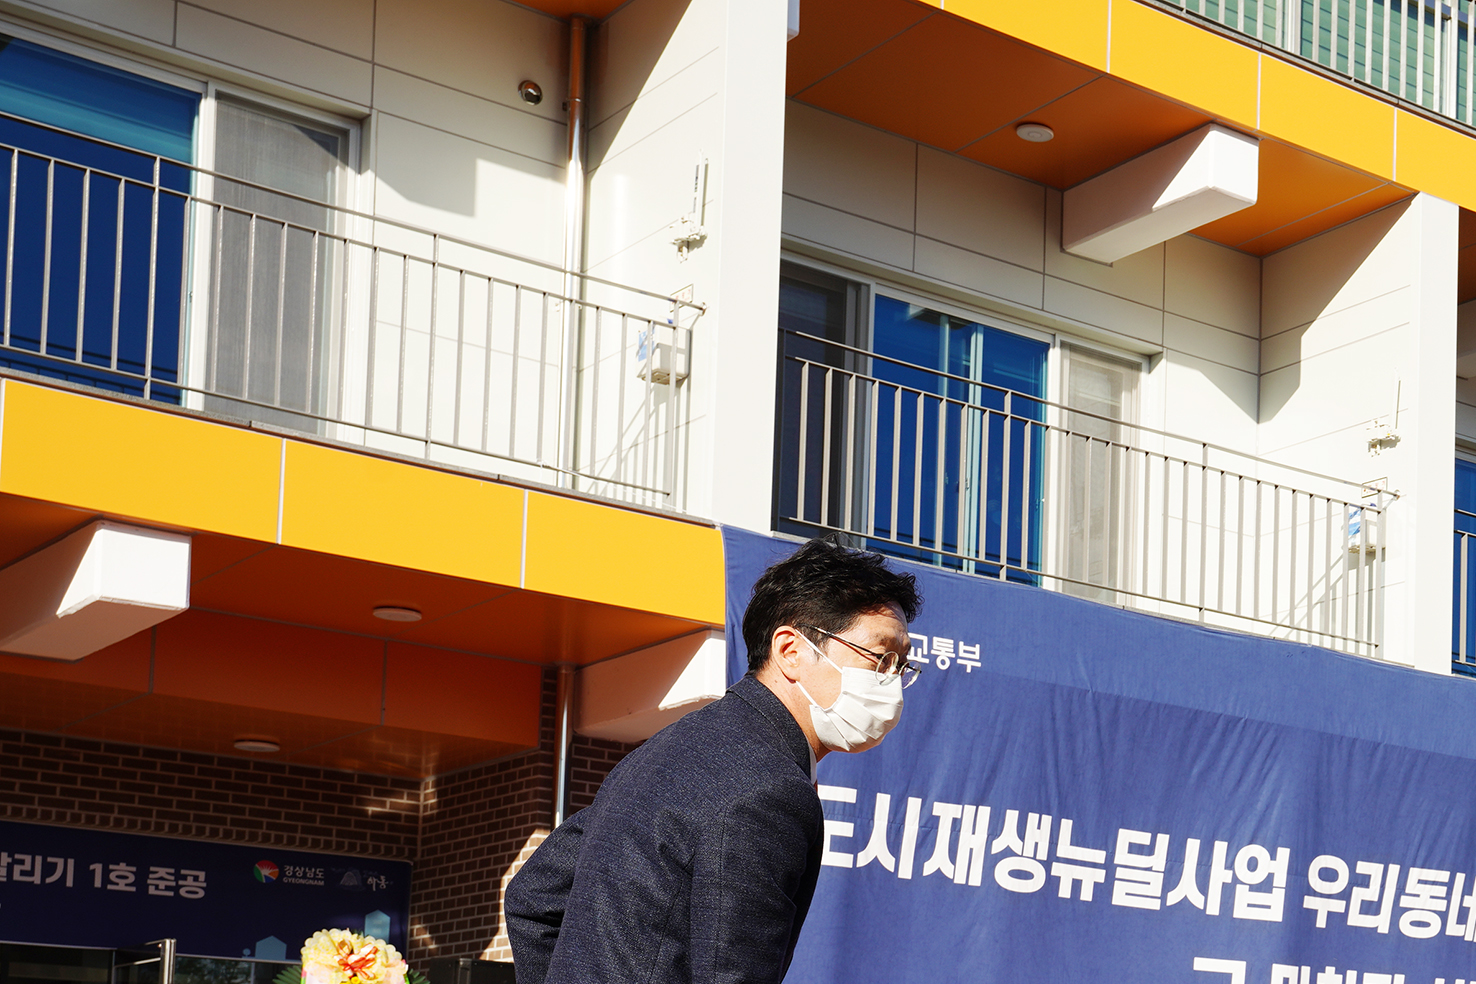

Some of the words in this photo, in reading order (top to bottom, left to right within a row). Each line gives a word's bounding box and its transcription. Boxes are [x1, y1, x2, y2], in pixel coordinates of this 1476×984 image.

[284, 864, 325, 879] 경상남도
[89, 862, 137, 892] 1호
[147, 866, 207, 899] 준공
[282, 877, 325, 887] GYEONGNAM
